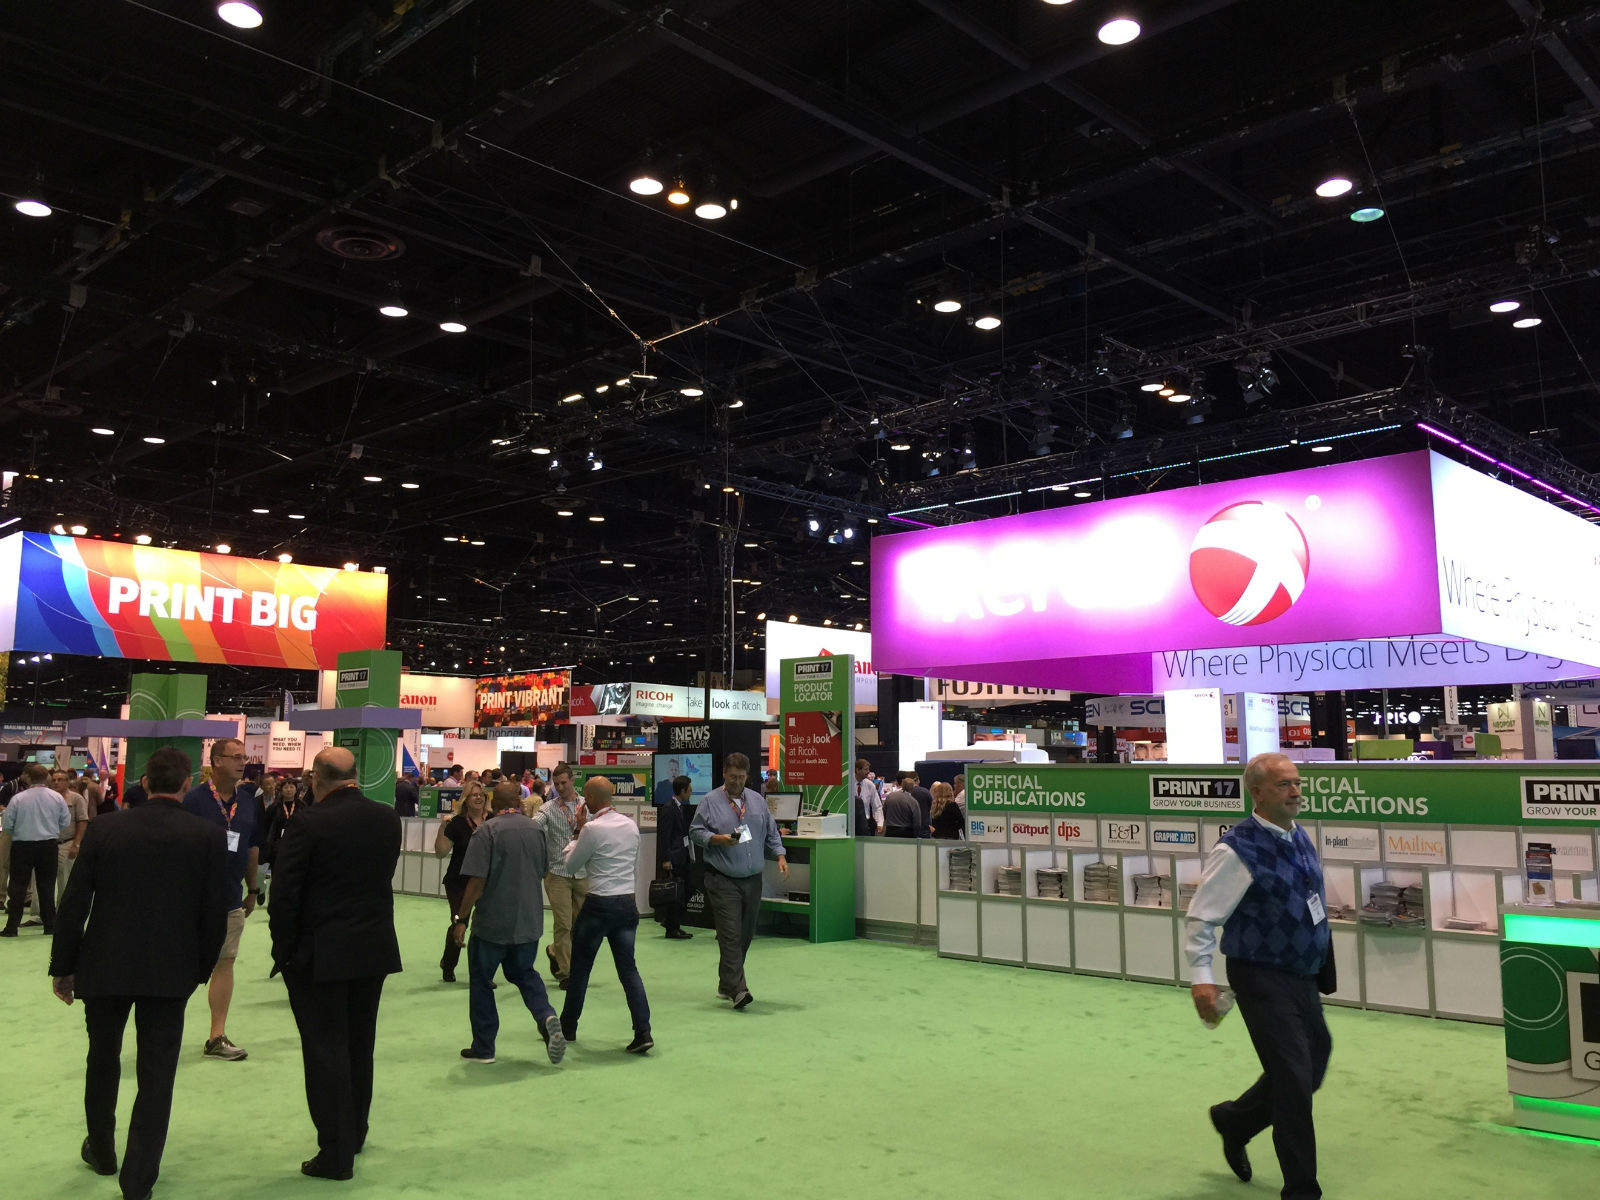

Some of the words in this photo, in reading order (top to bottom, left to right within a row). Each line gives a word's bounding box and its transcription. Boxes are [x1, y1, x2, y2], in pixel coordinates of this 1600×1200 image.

[108, 577, 243, 624] PRINT
[251, 589, 318, 631] BIG
[1163, 649, 1248, 679] Where
[1259, 642, 1374, 682] Physical
[1387, 636, 1490, 668] Meets
[797, 664, 820, 673] PRINT
[820, 663, 830, 671] 17
[341, 672, 360, 682] PRINT
[359, 671, 367, 681] 17
[794, 682, 833, 692] PRODUCT
[400, 695, 438, 705] anon
[480, 691, 513, 709] PRINT
[514, 687, 565, 707] VIBRANT
[636, 690, 674, 702] RICOH
[712, 698, 730, 710] look
[795, 692, 833, 702] LOCATOR
[675, 725, 711, 741] NEWS
[789, 734, 805, 744] Take
[806, 736, 811, 744] a
[813, 733, 831, 744] look
[675, 739, 710, 749] NETWORK
[788, 748, 796, 756] at
[797, 746, 819, 756] Ricoh.
[617, 781, 635, 794] PRINT
[972, 775, 1043, 790] OFFICIAL
[1158, 781, 1212, 796] PRINT
[1214, 781, 1235, 796] 17
[1300, 776, 1366, 794] FICIAL
[973, 790, 1087, 807] PUBLICATIONS
[1153, 799, 1178, 807] GROW
[1179, 800, 1202, 808] YOUR
[1298, 796, 1429, 816] BLICATIONS
[1526, 806, 1561, 816] GROW
[1564, 807, 1597, 816] YOUR
[971, 821, 985, 831] BIG
[1012, 824, 1049, 837] output
[1057, 821, 1081, 841] dps
[1108, 823, 1140, 840] E&P
[1154, 831, 1179, 842] GRAPHIC
[1180, 832, 1195, 843] ARTS
[1325, 835, 1349, 848] In-plant
